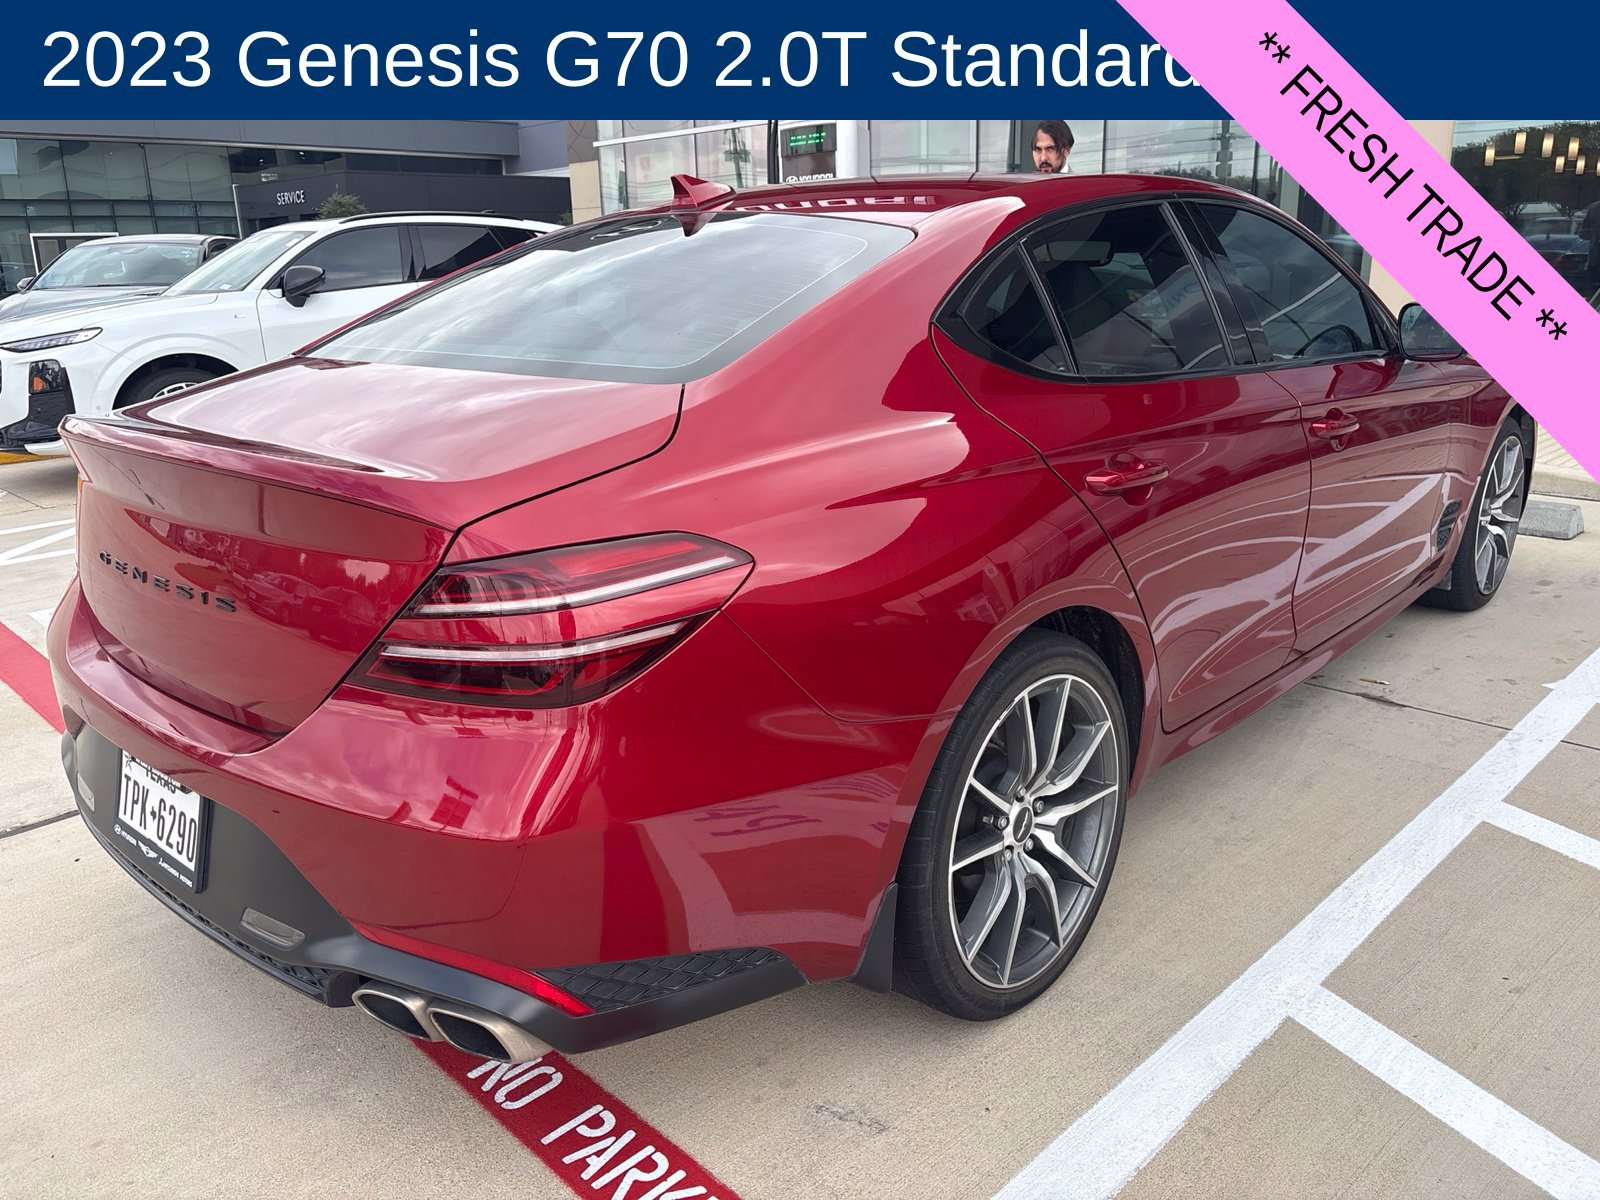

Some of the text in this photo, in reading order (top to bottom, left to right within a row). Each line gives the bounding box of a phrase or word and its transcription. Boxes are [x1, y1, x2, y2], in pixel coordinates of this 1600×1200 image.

[276, 190, 306, 206] SERVICE
[99, 550, 237, 613] GENESIS
[466, 1056, 720, 1200] NO PARK
